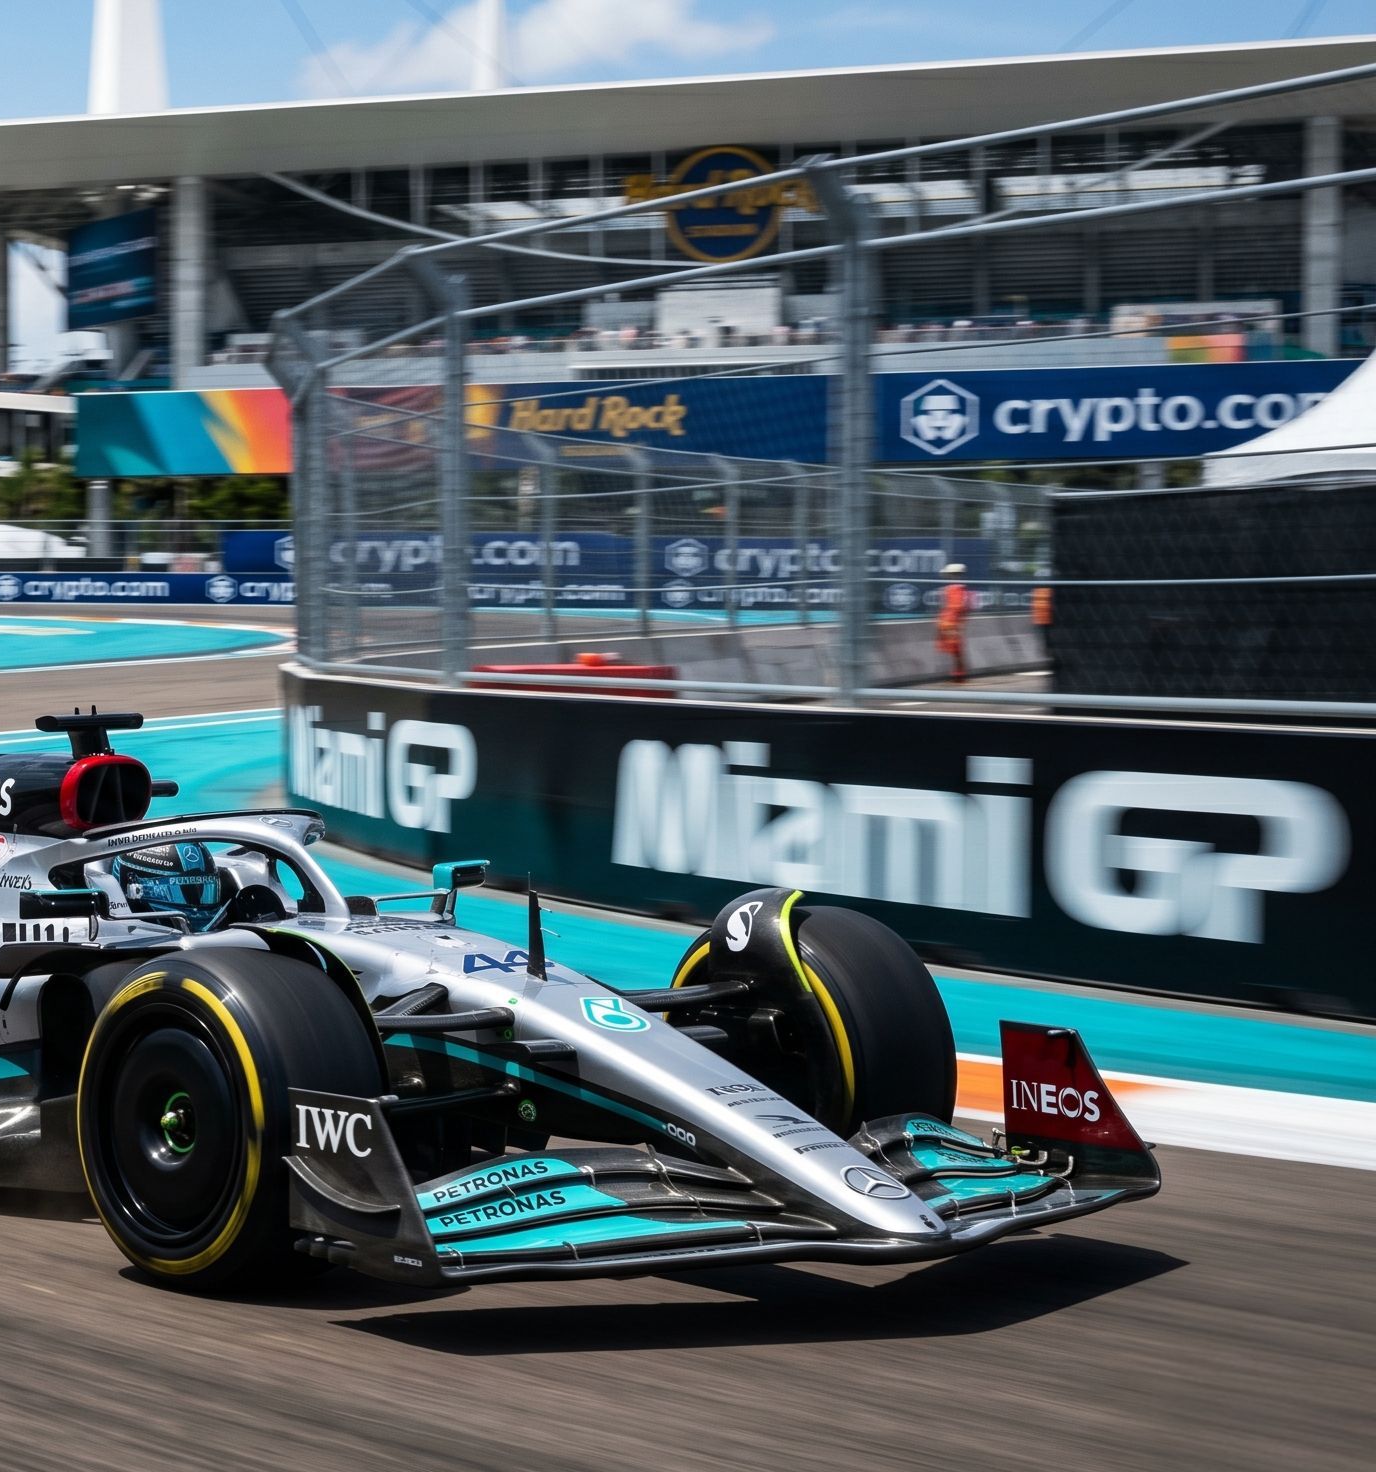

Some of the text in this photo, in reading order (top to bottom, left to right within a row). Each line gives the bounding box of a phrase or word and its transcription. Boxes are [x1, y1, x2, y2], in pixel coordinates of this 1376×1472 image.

[508, 395, 687, 437] Hard Rock
[328, 535, 581, 572] crypt.com
[24, 578, 170, 601] crypto.com
[288, 705, 478, 833] Miami GP
[611, 738, 1353, 944] Miami GP
[1010, 1079, 1101, 1122] INEOS
[295, 1104, 373, 1158] IWC
[433, 1161, 549, 1203] PETRONAS
[440, 1190, 566, 1228] PETRONAS
